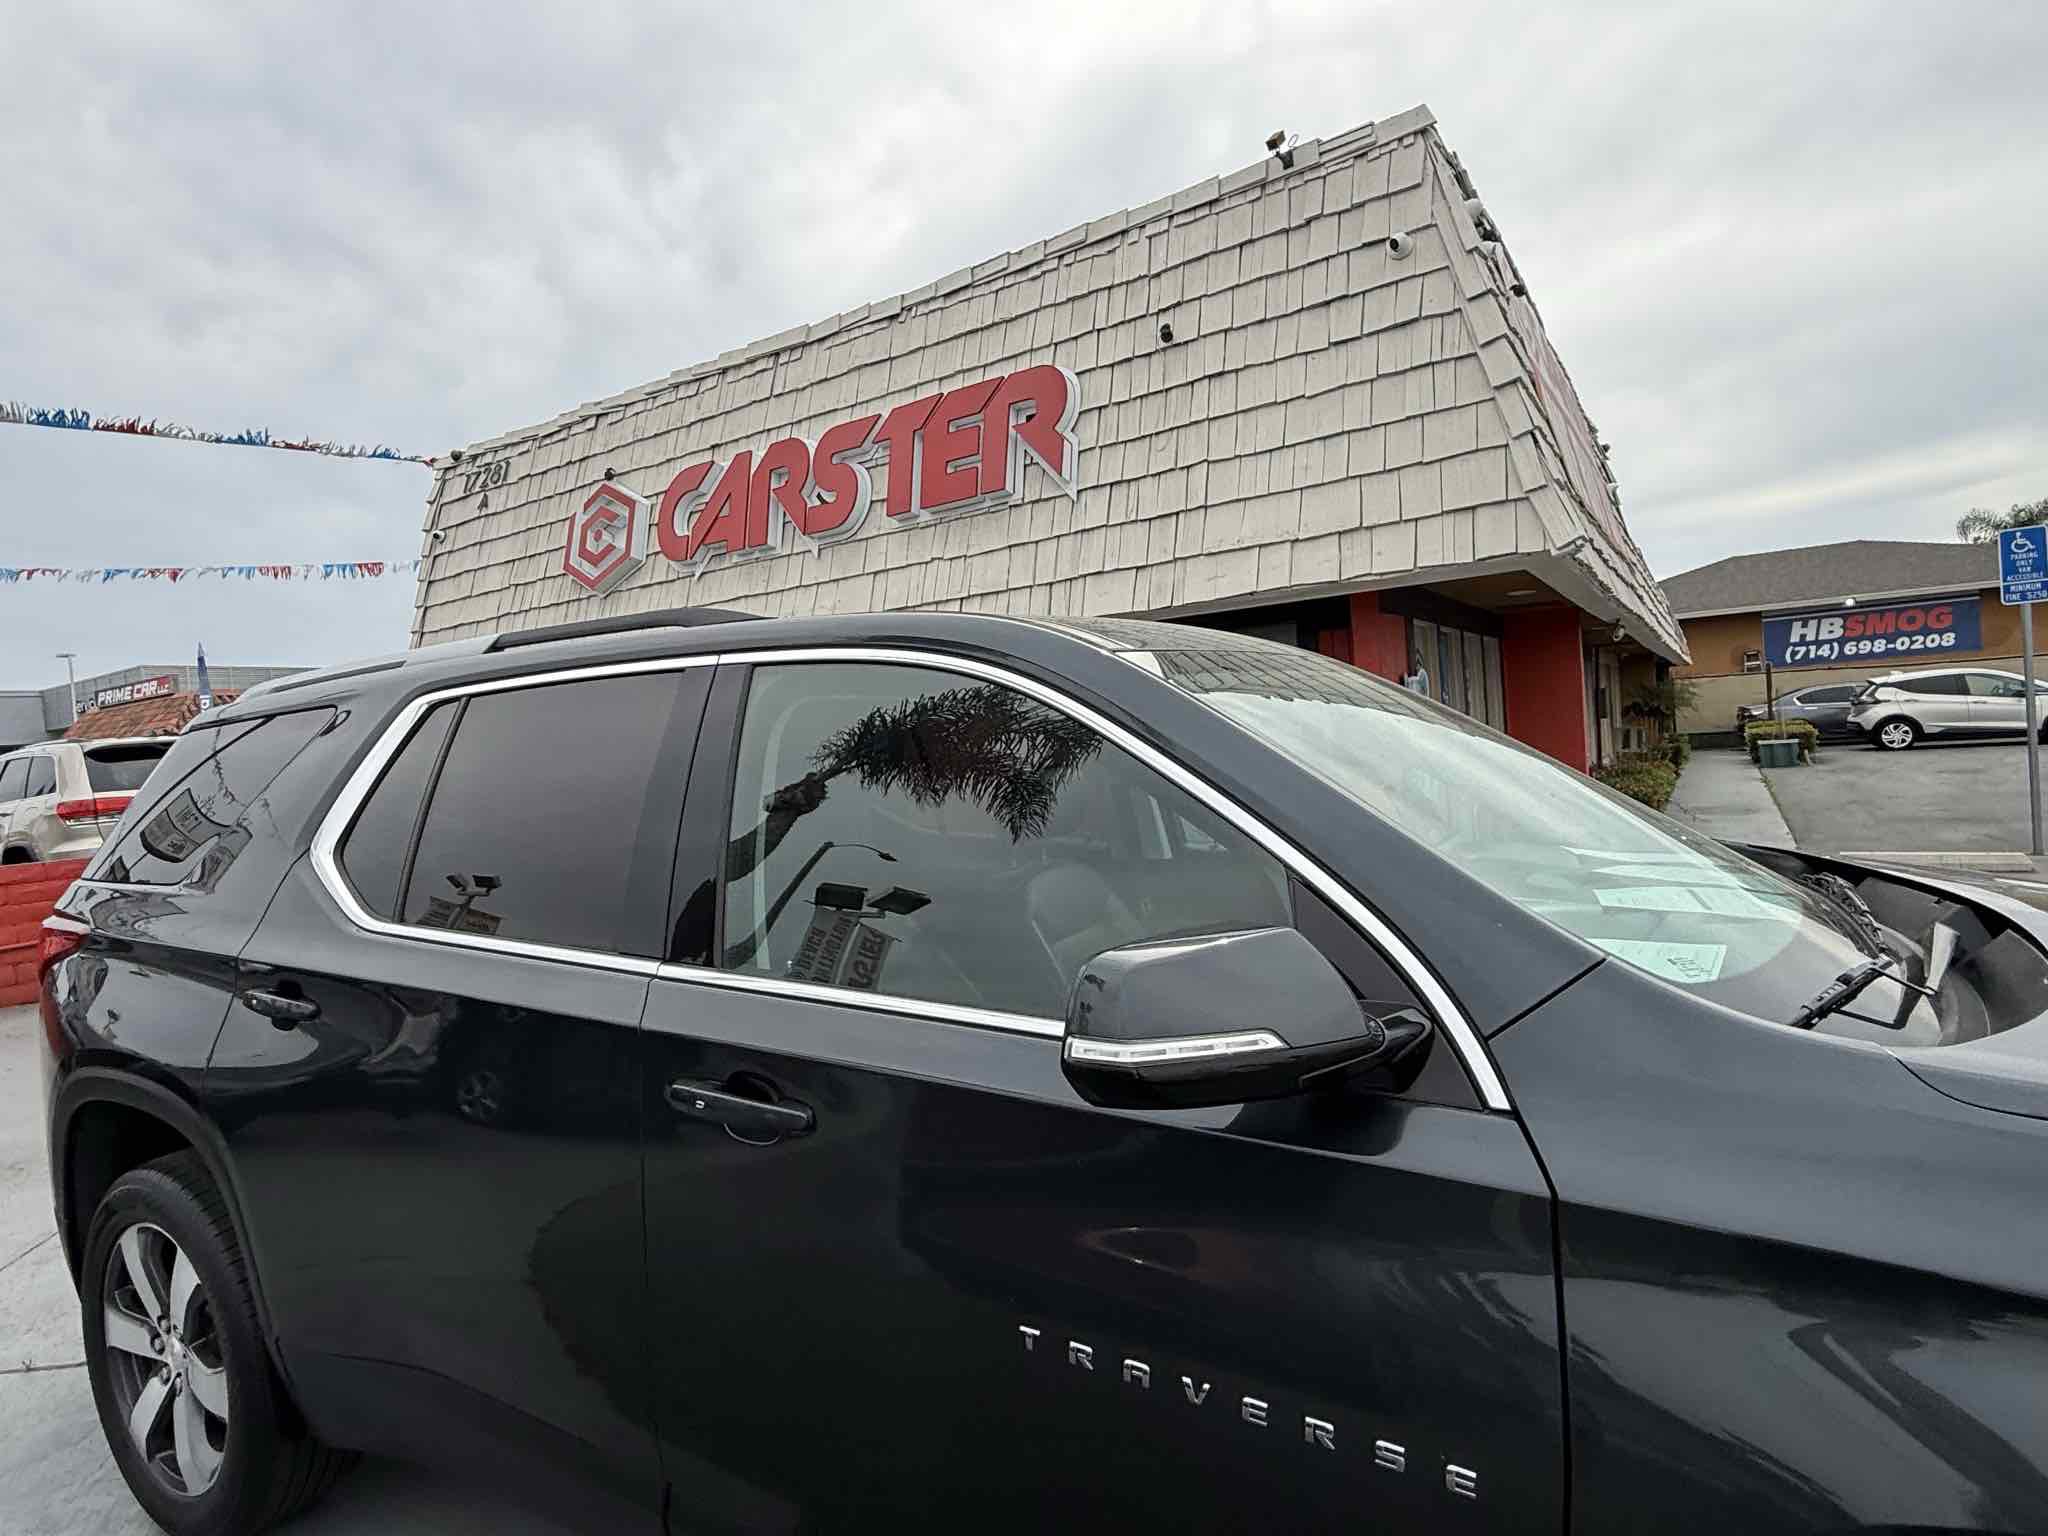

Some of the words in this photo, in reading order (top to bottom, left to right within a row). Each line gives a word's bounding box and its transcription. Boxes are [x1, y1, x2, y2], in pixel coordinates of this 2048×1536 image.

[657, 364, 1072, 567] CARSTER
[2010, 551, 2039, 560] PARKING
[2005, 593, 2022, 601] FINE
[2010, 583, 2042, 592] MINIMUM
[1785, 642, 1839, 664] (714)
[1843, 632, 1956, 656] 698-0208
[98, 687, 133, 706] PRIME
[133, 680, 158, 699] CAR
[1018, 1325, 1478, 1498] TRAVERSE
